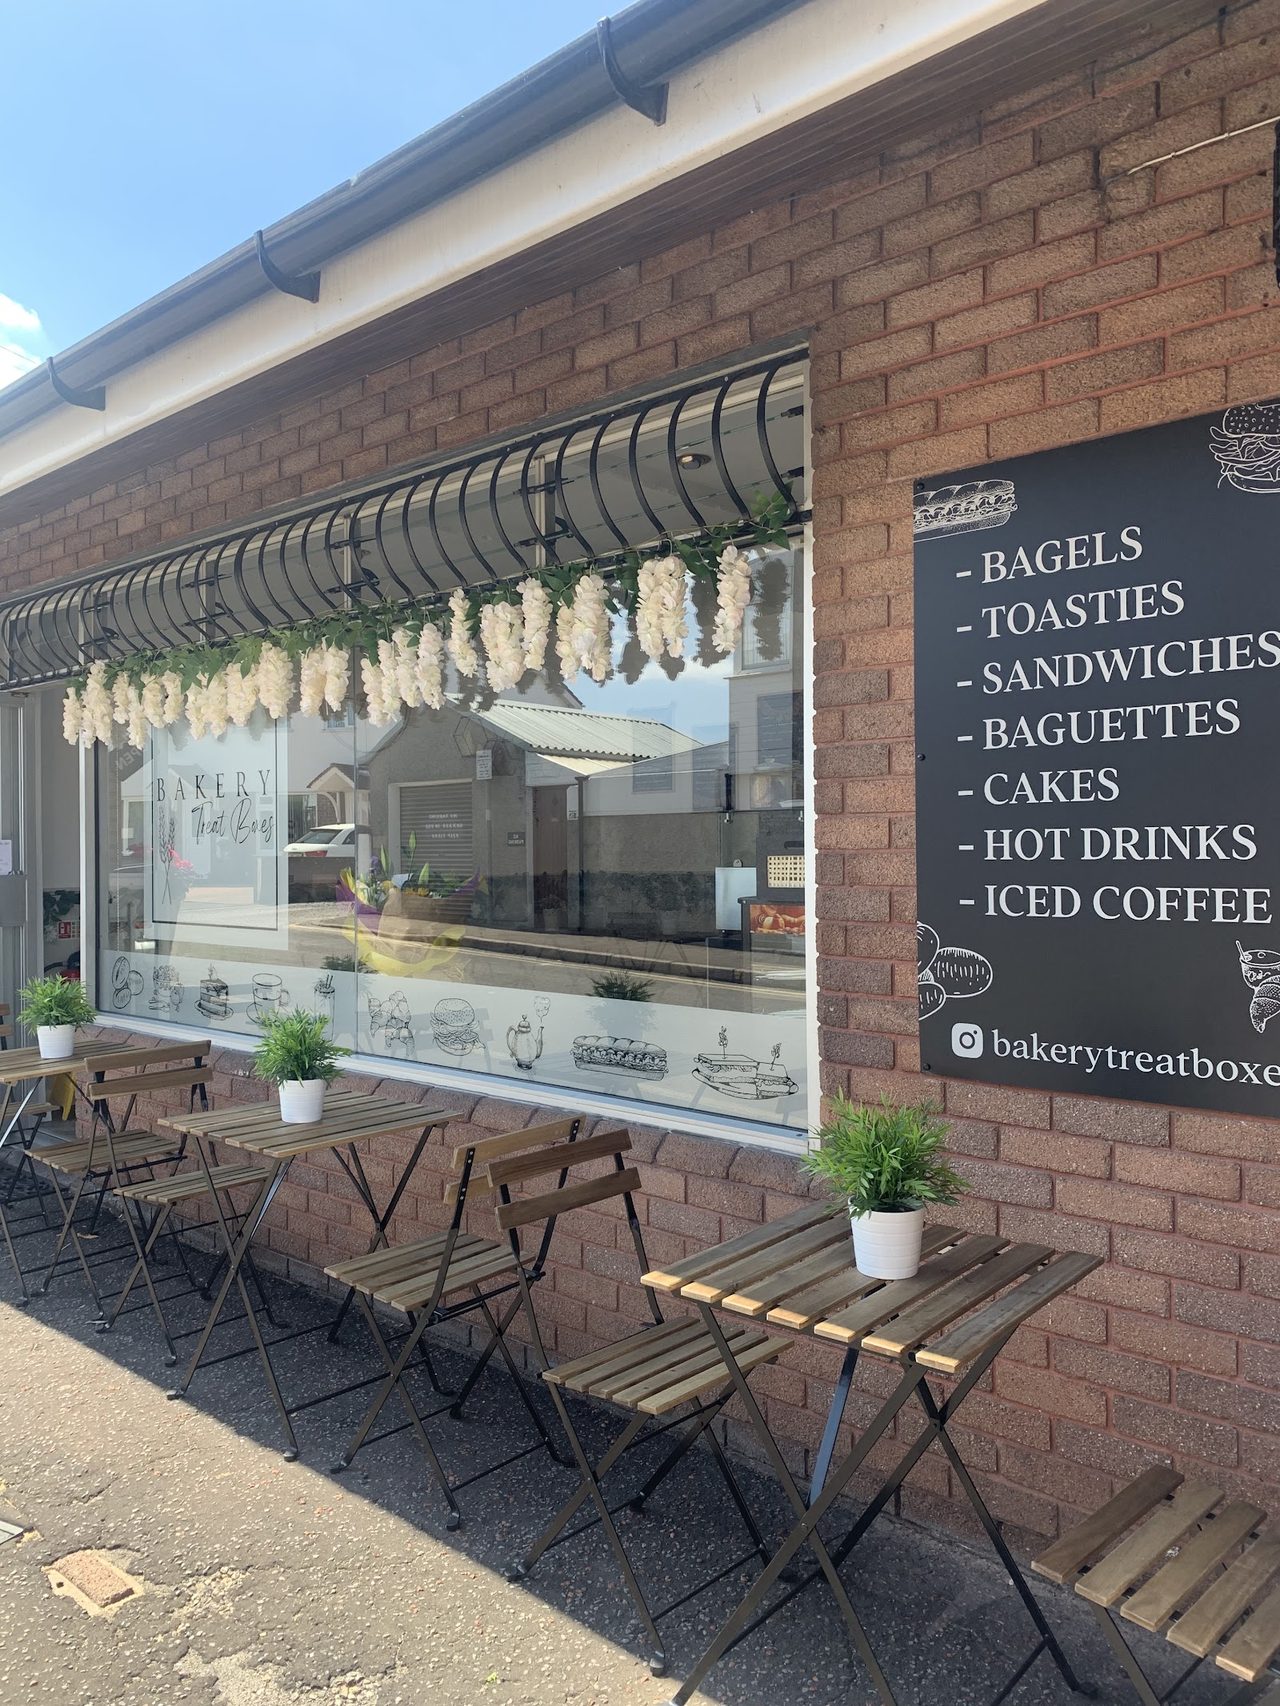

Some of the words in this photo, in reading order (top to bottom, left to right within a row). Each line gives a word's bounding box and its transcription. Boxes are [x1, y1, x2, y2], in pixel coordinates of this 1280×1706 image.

[982, 526, 1143, 584] BAGELS
[982, 581, 1185, 639] TOASTIES
[982, 630, 1280, 695] SANDWICHES
[983, 698, 1241, 750] BAGUETTES
[156, 769, 271, 802] BAKERY
[983, 767, 1120, 805] CAKES
[191, 801, 226, 846] Treat
[983, 827, 1071, 861] HOT
[1080, 824, 1258, 861] DRINKS
[985, 884, 1081, 918] ICED
[1092, 886, 1273, 924] COFFEE
[991, 1028, 1280, 1087] bakerytreatboxe
